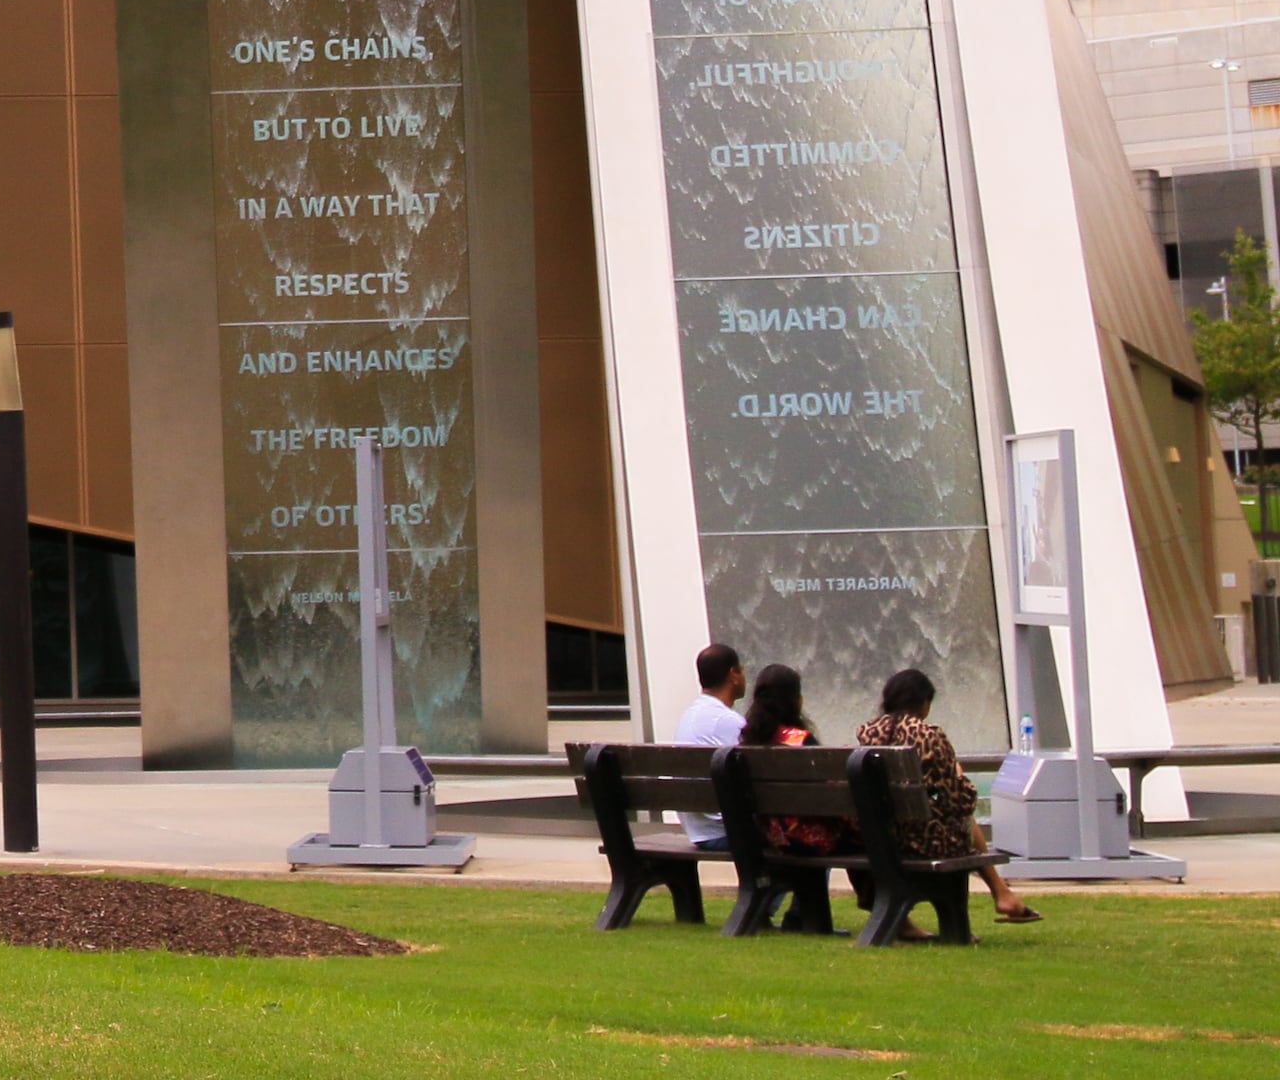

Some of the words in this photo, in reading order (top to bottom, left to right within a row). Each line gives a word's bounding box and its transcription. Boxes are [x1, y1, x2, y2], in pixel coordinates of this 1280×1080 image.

[235, 37, 315, 64] ONE'S
[253, 118, 307, 141] BUT
[314, 117, 351, 139] TO
[361, 115, 420, 138] LIVE
[238, 197, 266, 220] IN
[275, 197, 292, 218] A
[300, 195, 361, 218] WAY
[368, 192, 440, 216] THAT
[275, 271, 411, 297] RESPECTS
[240, 352, 297, 374] AND
[307, 347, 454, 373] ENHANCES
[250, 429, 304, 451] THE
[271, 506, 306, 527] OF
[315, 503, 430, 527] OTRS.
[292, 591, 343, 603] NELSON
[348, 590, 413, 602] MELA
